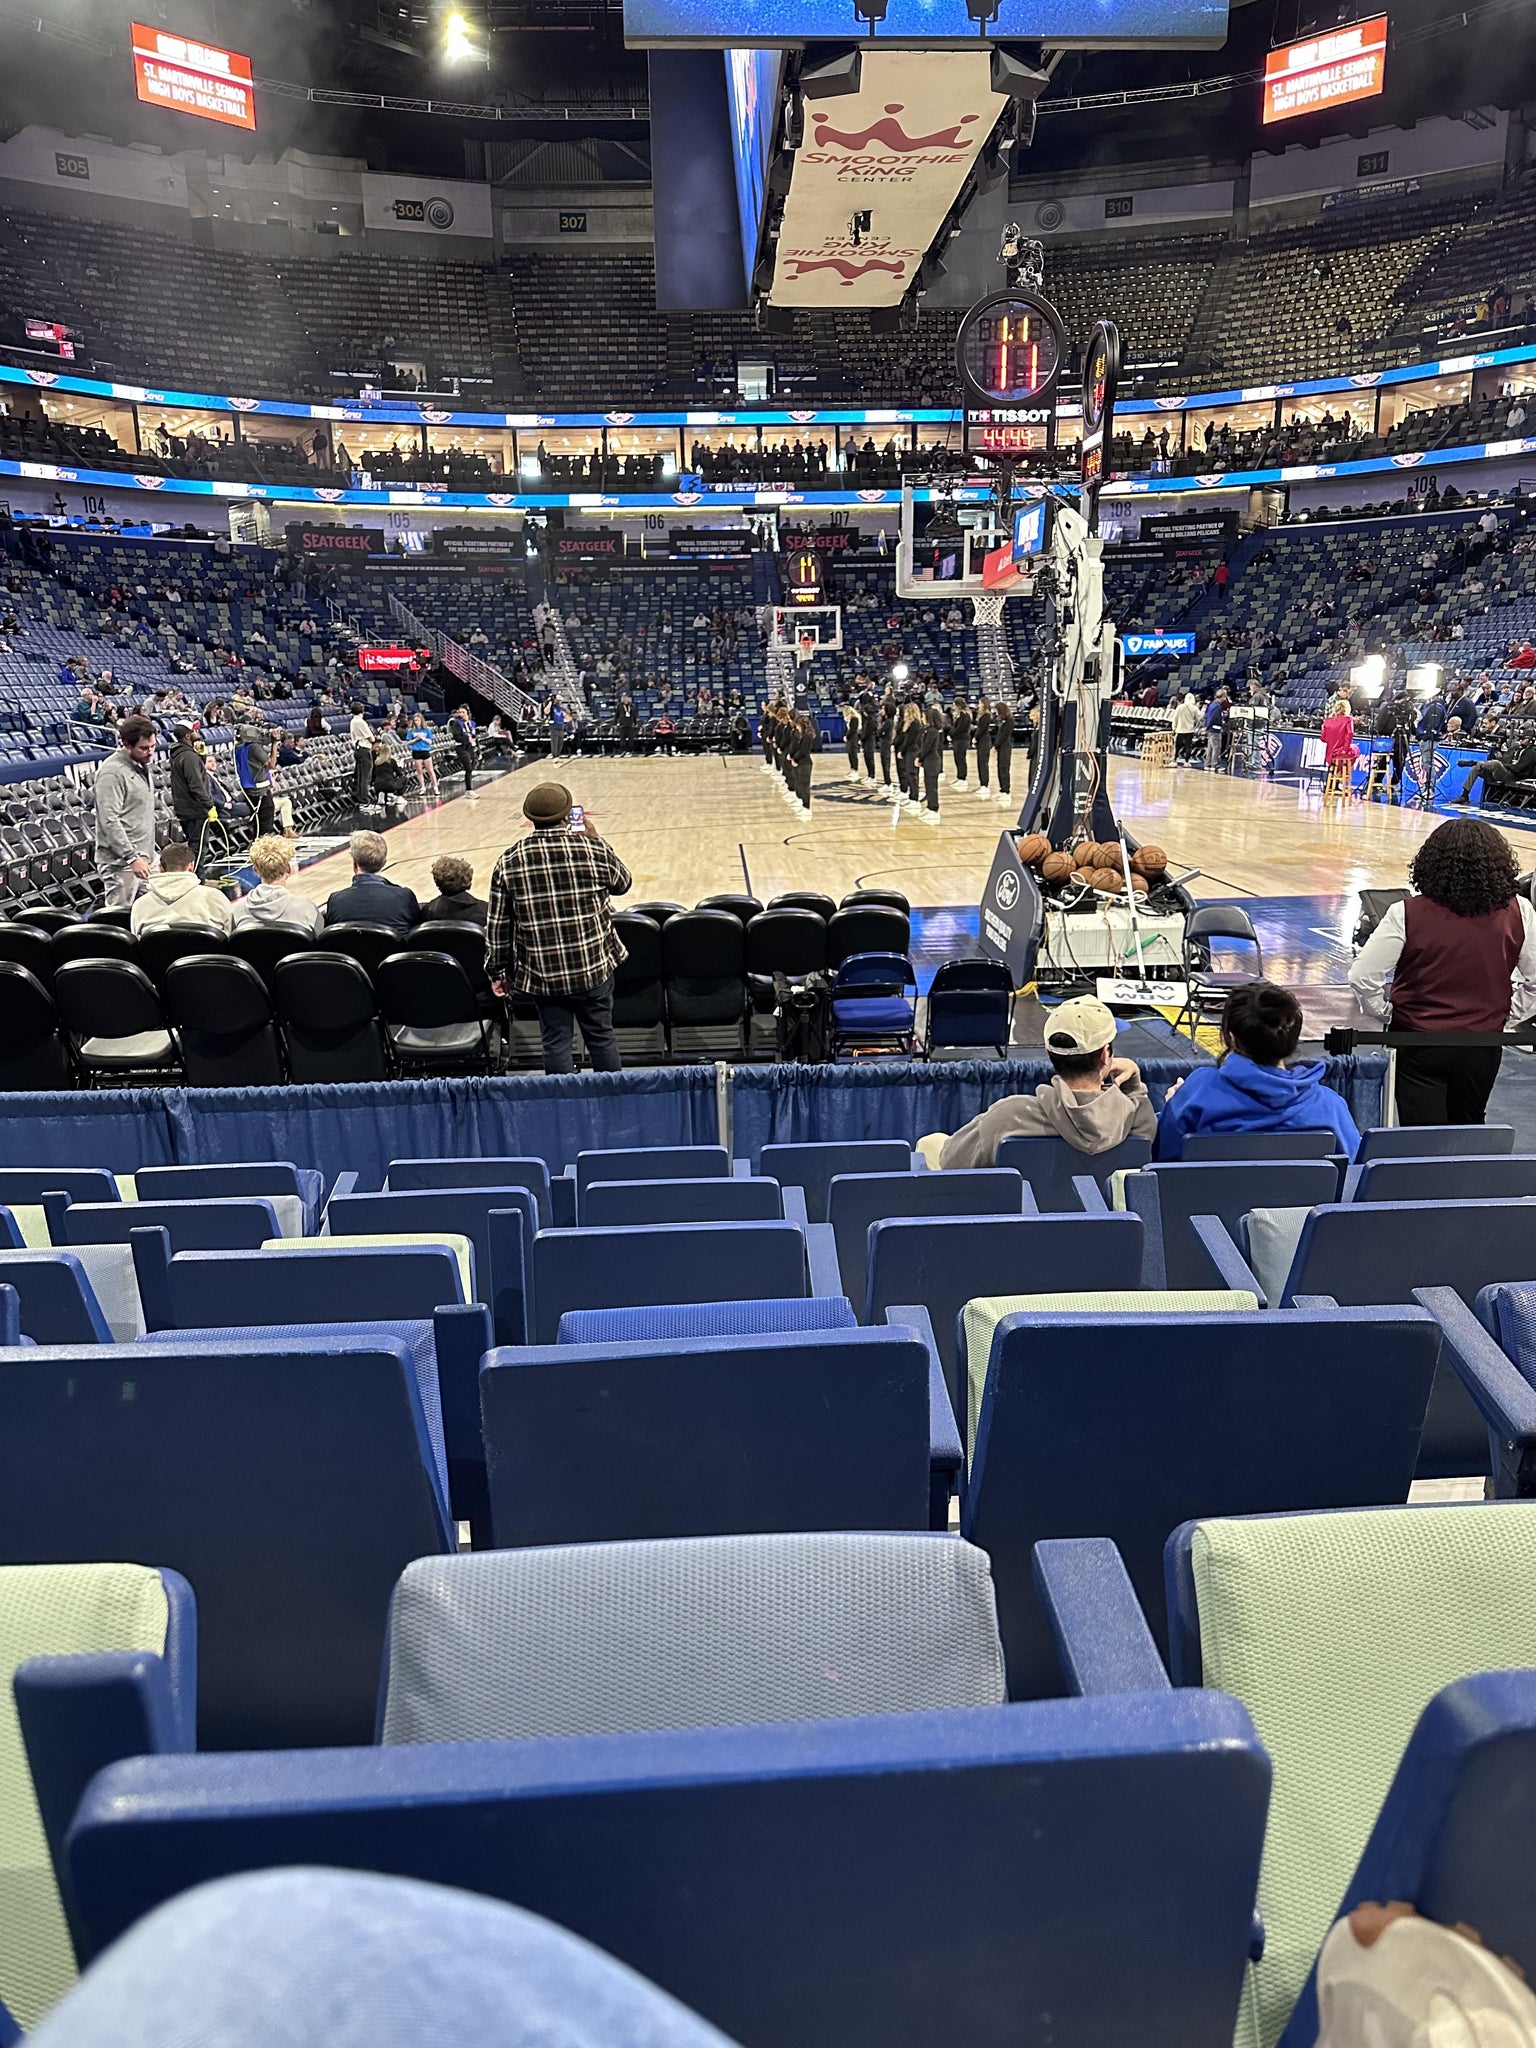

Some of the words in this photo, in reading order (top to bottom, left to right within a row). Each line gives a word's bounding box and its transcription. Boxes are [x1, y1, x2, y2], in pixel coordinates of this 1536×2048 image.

[1320, 72, 1374, 99] BASKETBALL
[196, 91, 247, 119] BASKETBALL
[58, 158, 87, 175] 305
[800, 153, 969, 164] SMOOTHIE
[1361, 156, 1384, 172] 311
[1372, 181, 1405, 192] PROBLEMS
[397, 204, 423, 218] 306
[1108, 200, 1130, 214] 310
[560, 216, 585, 229] 307
[782, 249, 920, 257] SMOOTHIE
[992, 410, 1051, 423] TISSOT
[1414, 475, 1437, 494] 109
[82, 495, 106, 515] 104
[1110, 501, 1132, 518] 108
[387, 512, 410, 529] 105
[643, 514, 665, 530] 106
[829, 511, 850, 527] 107
[1196, 522, 1217, 530] PARTNER
[303, 533, 372, 550] SEATGEEK
[558, 539, 617, 553] SEATGEEK
[785, 534, 850, 550] SEAGEEK
